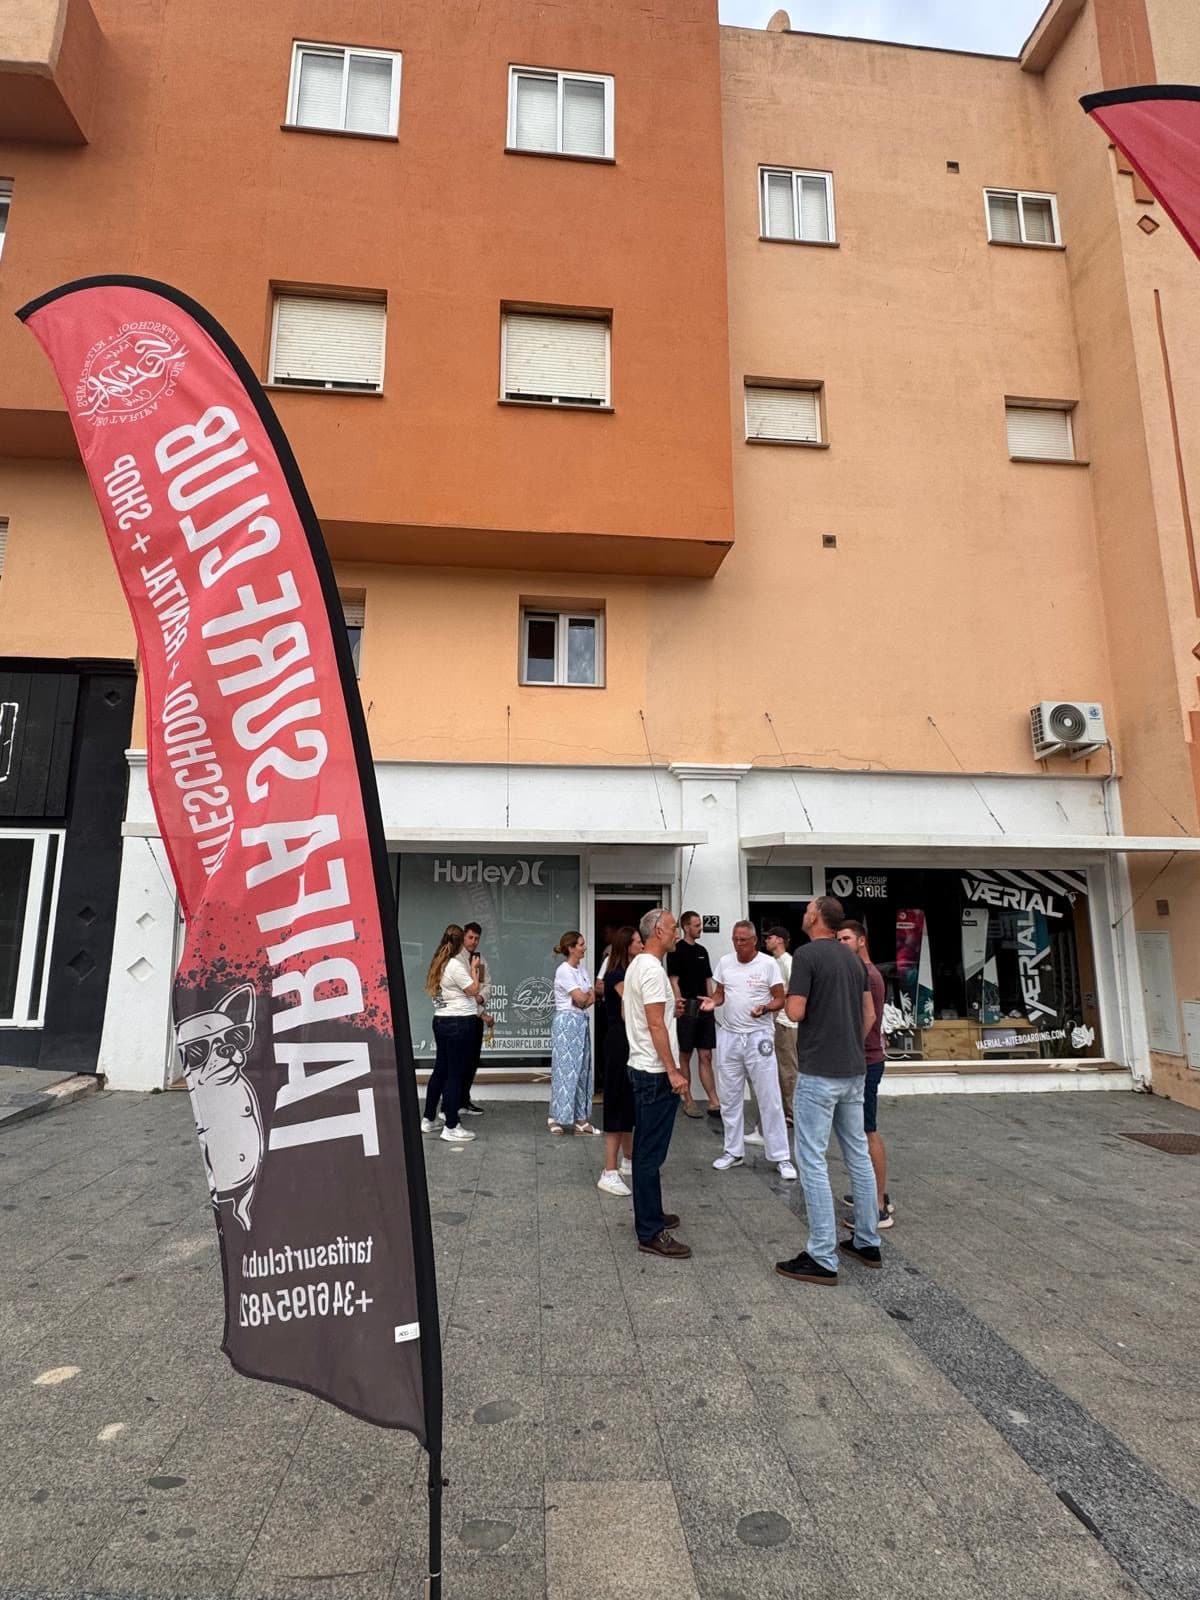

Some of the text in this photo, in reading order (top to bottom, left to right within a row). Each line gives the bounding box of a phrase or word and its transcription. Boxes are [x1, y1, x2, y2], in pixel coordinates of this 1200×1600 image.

[433, 859, 517, 886] Hurley
[856, 876, 888, 885] FLAGSHIP
[856, 885, 888, 898] STORE
[704, 916, 718, 928] 23
[485, 1039, 553, 1049] TARIFASURFCLUB.CO
